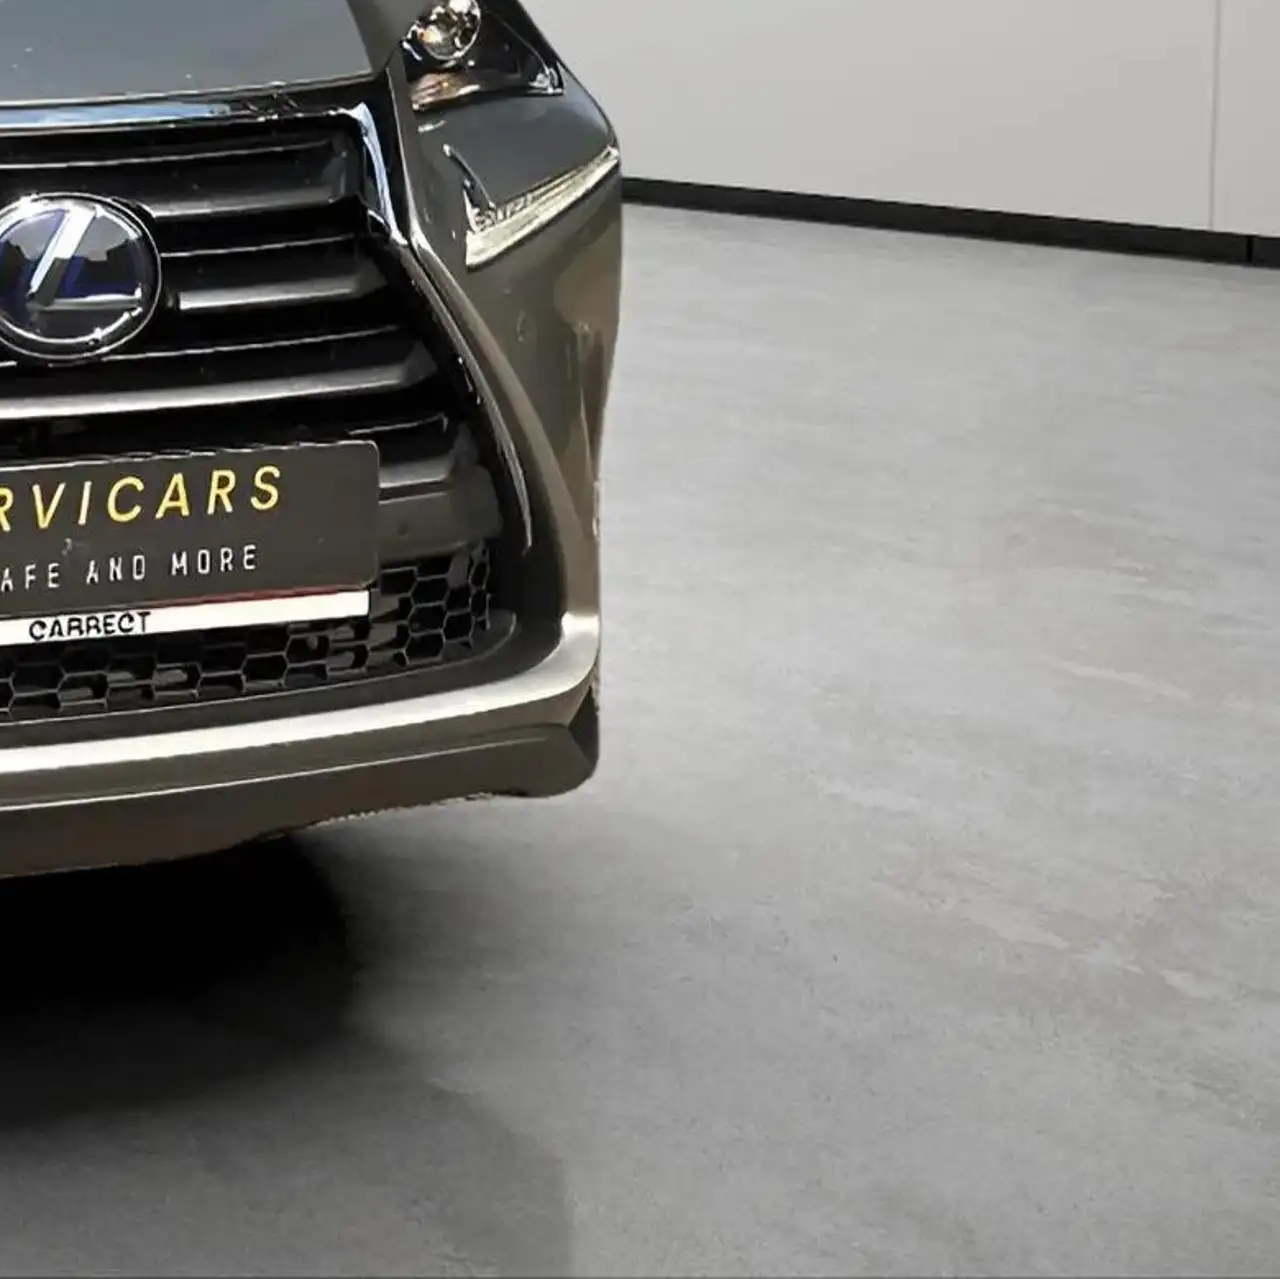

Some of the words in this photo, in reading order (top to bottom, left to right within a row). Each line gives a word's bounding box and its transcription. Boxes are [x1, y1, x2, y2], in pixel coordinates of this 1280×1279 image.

[85, 554, 146, 585] AND
[171, 545, 258, 576] MORE
[29, 611, 151, 640] CARRECT
